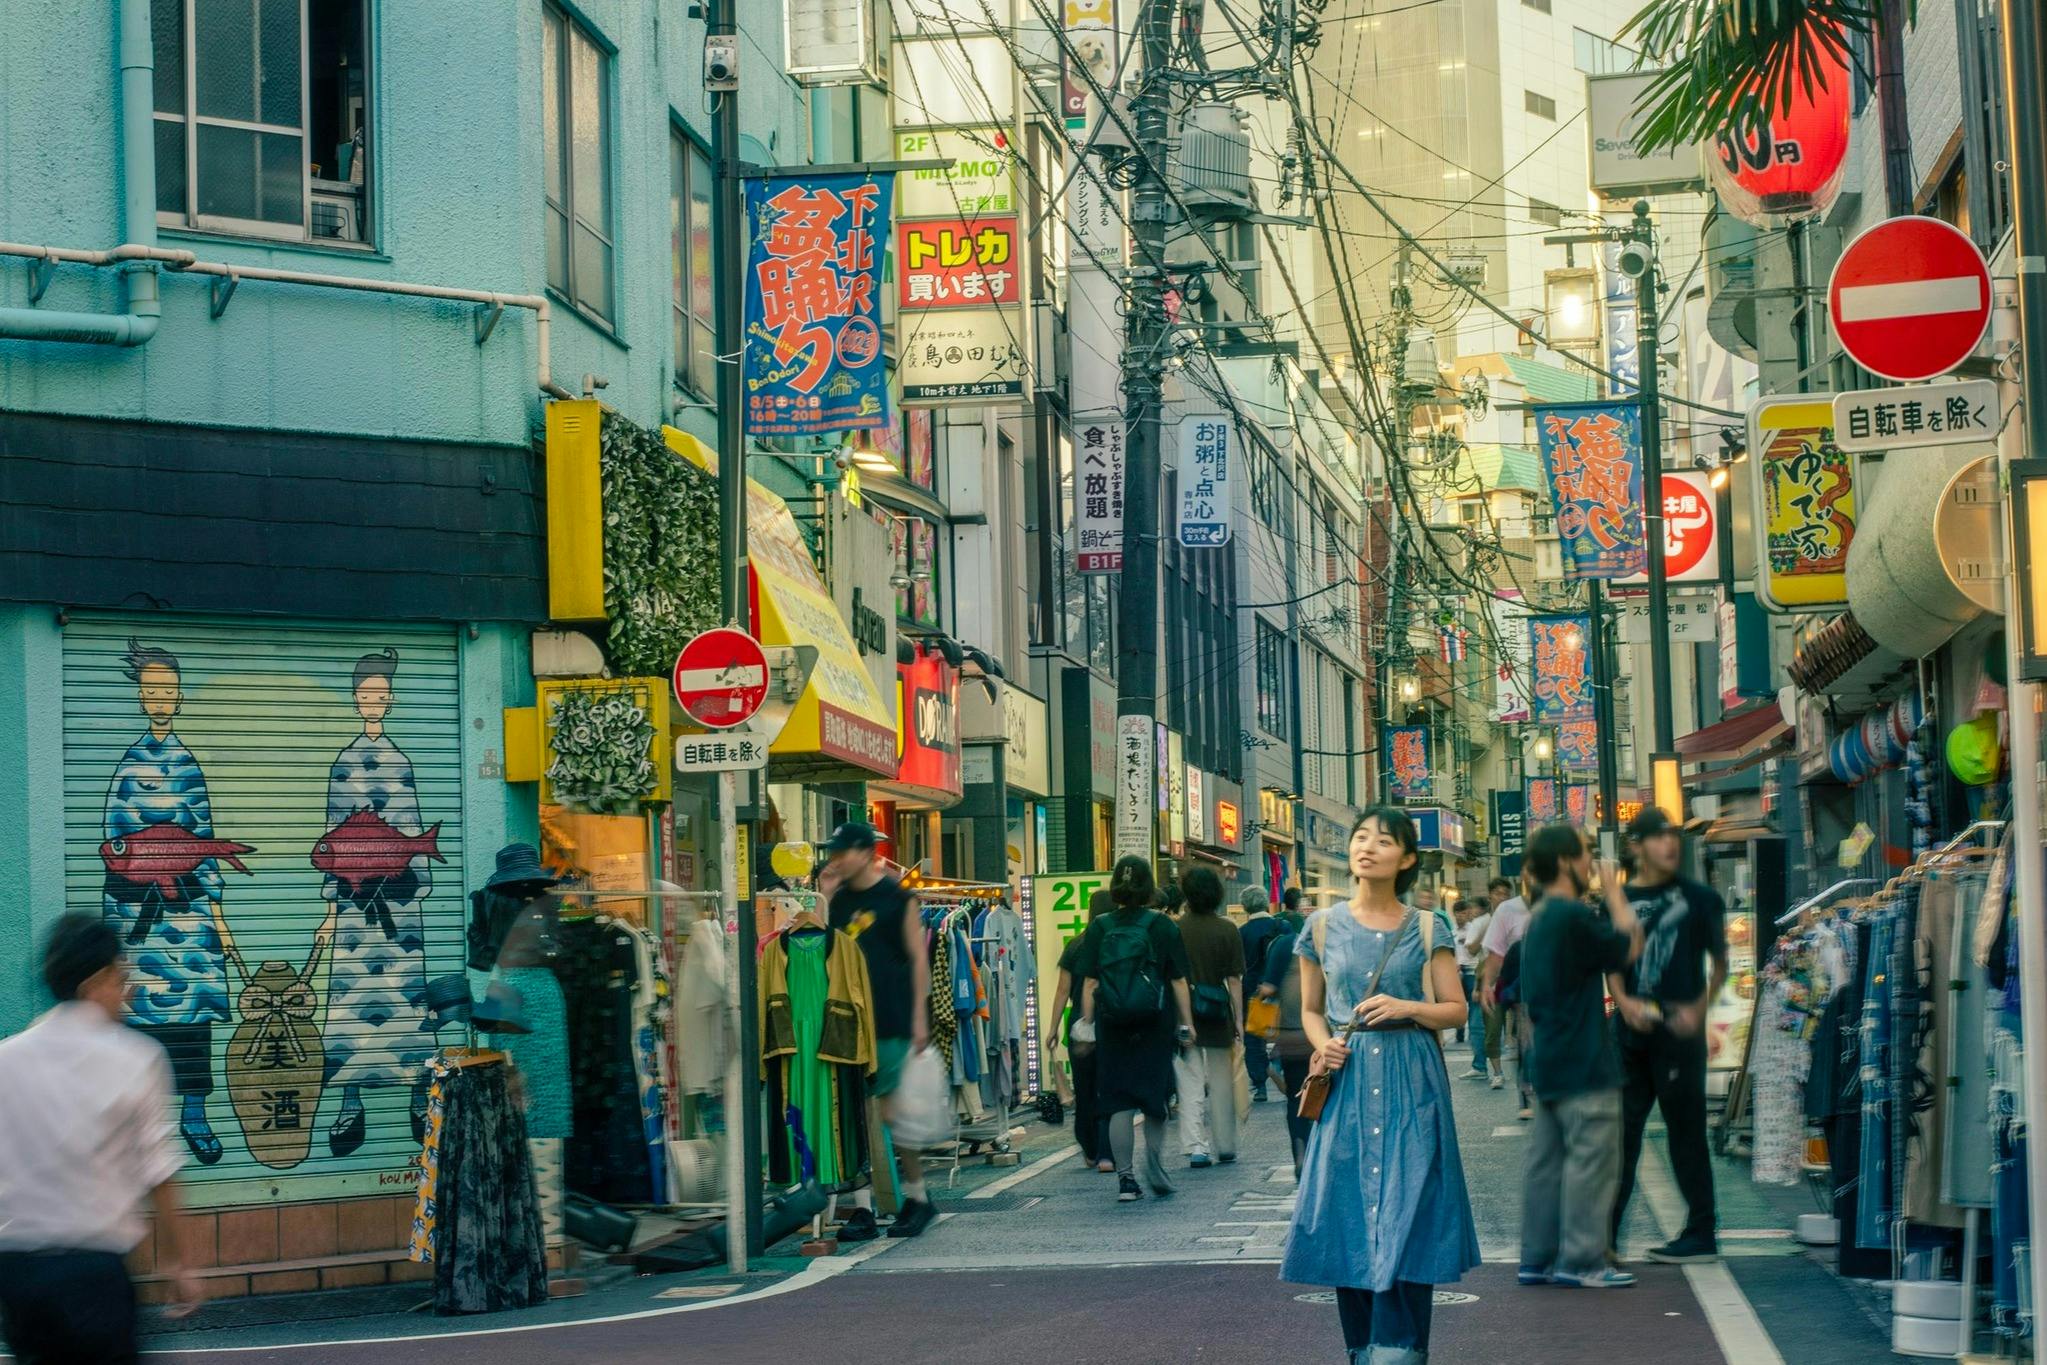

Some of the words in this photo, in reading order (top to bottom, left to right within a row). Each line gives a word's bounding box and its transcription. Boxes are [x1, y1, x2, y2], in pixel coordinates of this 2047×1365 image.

[904, 137, 929, 152] 2F
[838, 183, 881, 316] 下北沢
[908, 228, 1011, 270] トレカ
[756, 184, 848, 394] 盆踊り
[908, 271, 1012, 302] 買います
[1849, 396, 1987, 439] 自転車を除く
[1083, 426, 1109, 519] 食べ放題
[1110, 425, 1124, 519] しゃぶしゃぶすき焼き
[1194, 422, 1216, 520] お粥と点心
[1089, 554, 1122, 569] B1F
[1674, 623, 1689, 633] 2F
[1695, 602, 1708, 614] 松
[684, 741, 762, 764] 自転車を除く
[1126, 736, 1142, 822] 酒場たいよう
[1501, 813, 1522, 856] STEPS
[1052, 880, 1102, 912] 2F
